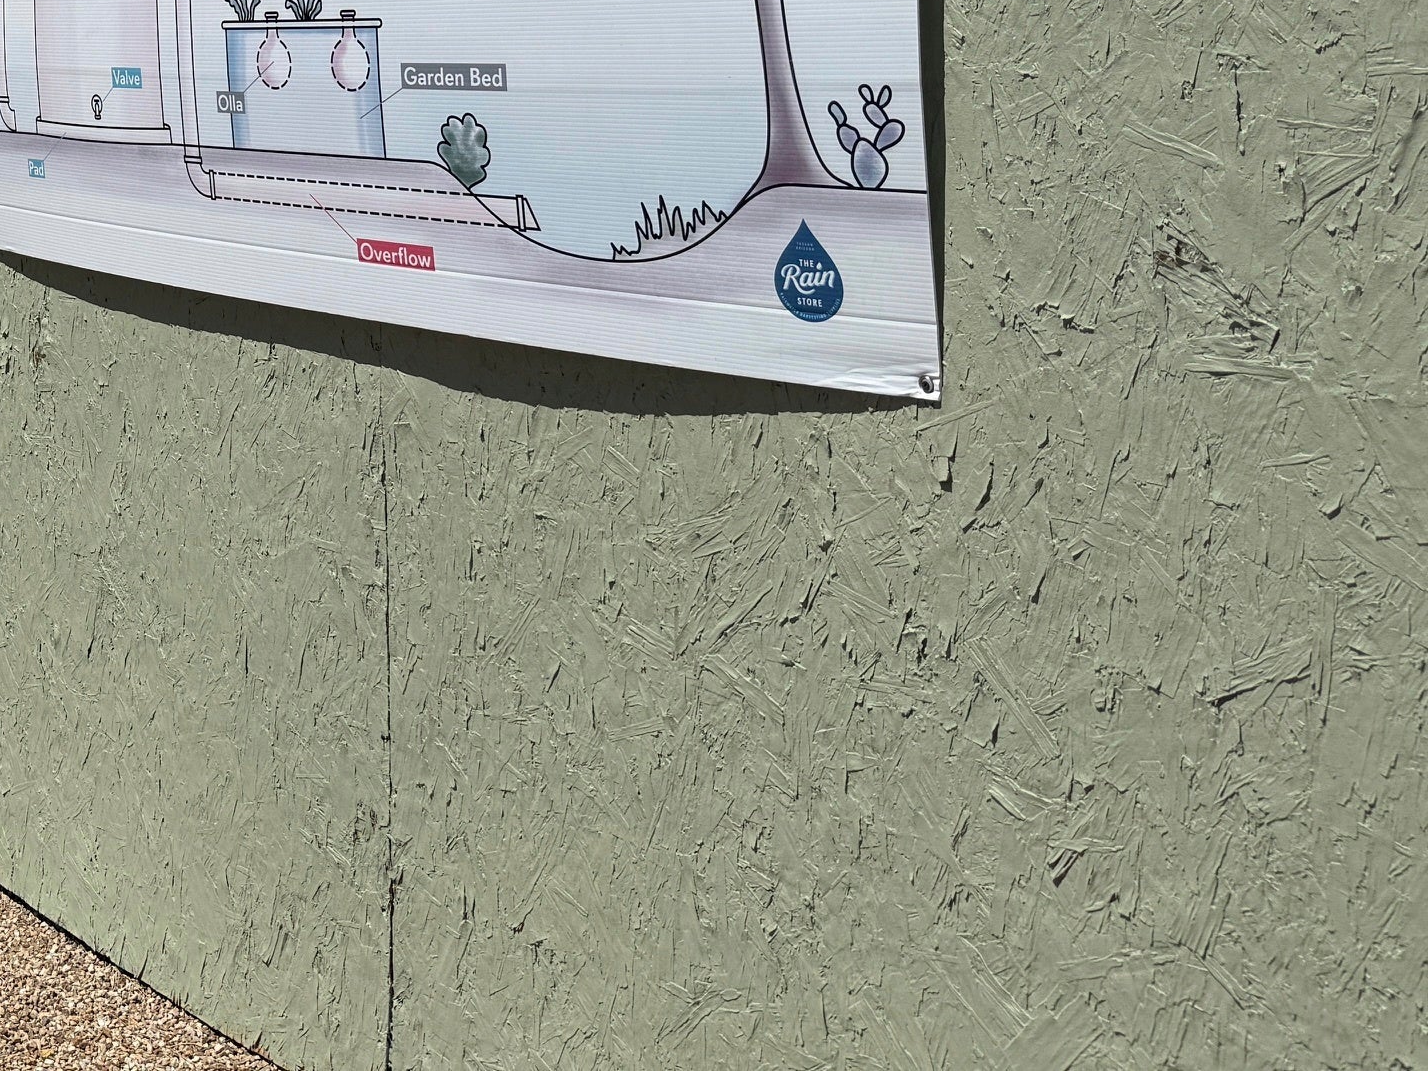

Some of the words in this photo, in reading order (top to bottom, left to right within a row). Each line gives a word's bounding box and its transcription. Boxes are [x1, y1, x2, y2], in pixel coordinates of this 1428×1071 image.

[112, 70, 140, 86] Valve
[403, 66, 465, 87] Garden
[469, 67, 503, 87] Bed
[217, 94, 244, 113] Olla
[29, 161, 44, 176] Pad
[360, 242, 431, 269] Overflow
[798, 258, 815, 268] THE
[781, 262, 835, 294] Rain
[797, 297, 823, 308] STORE
